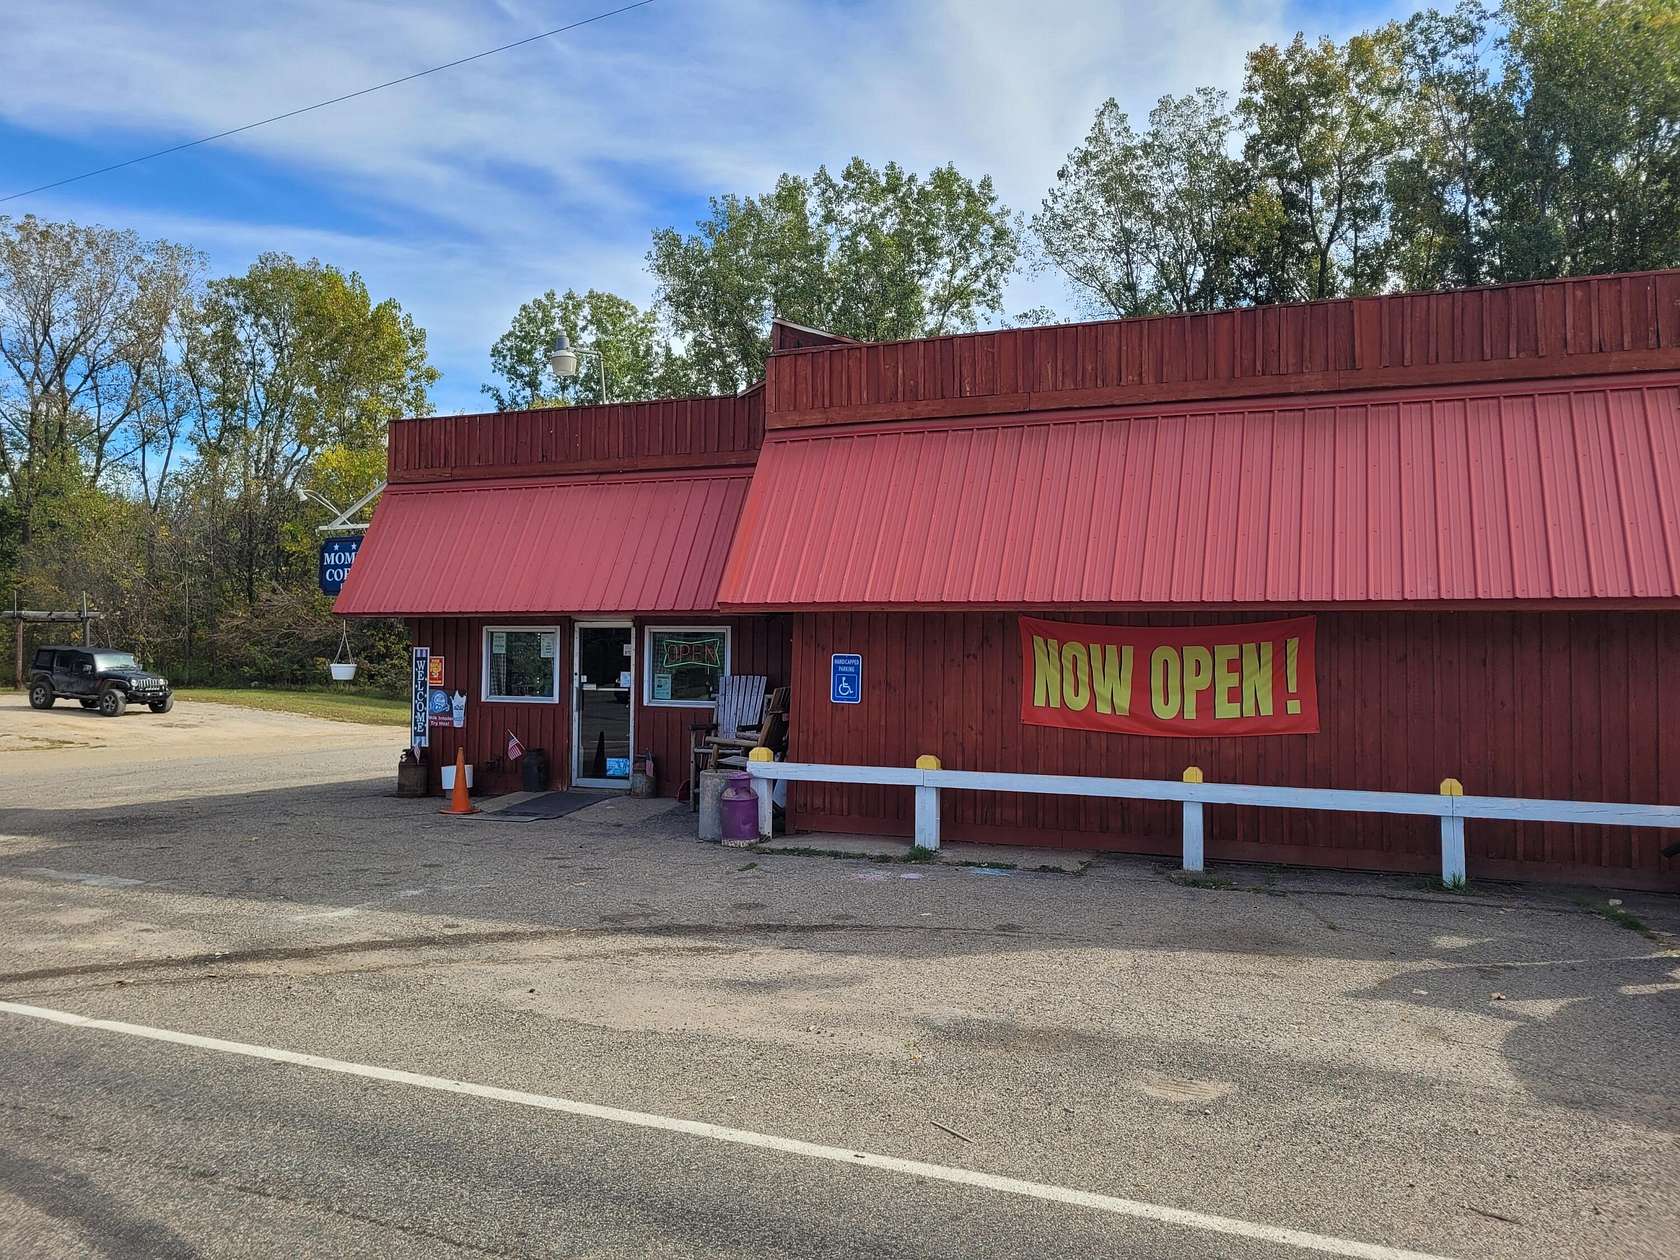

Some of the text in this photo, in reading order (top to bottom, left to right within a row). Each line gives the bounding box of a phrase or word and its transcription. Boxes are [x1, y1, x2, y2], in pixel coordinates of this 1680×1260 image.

[667, 644, 716, 663] OPEN
[838, 665, 856, 673] PARKING
[1032, 635, 1134, 716] NOW
[416, 660, 426, 733] WELCOME
